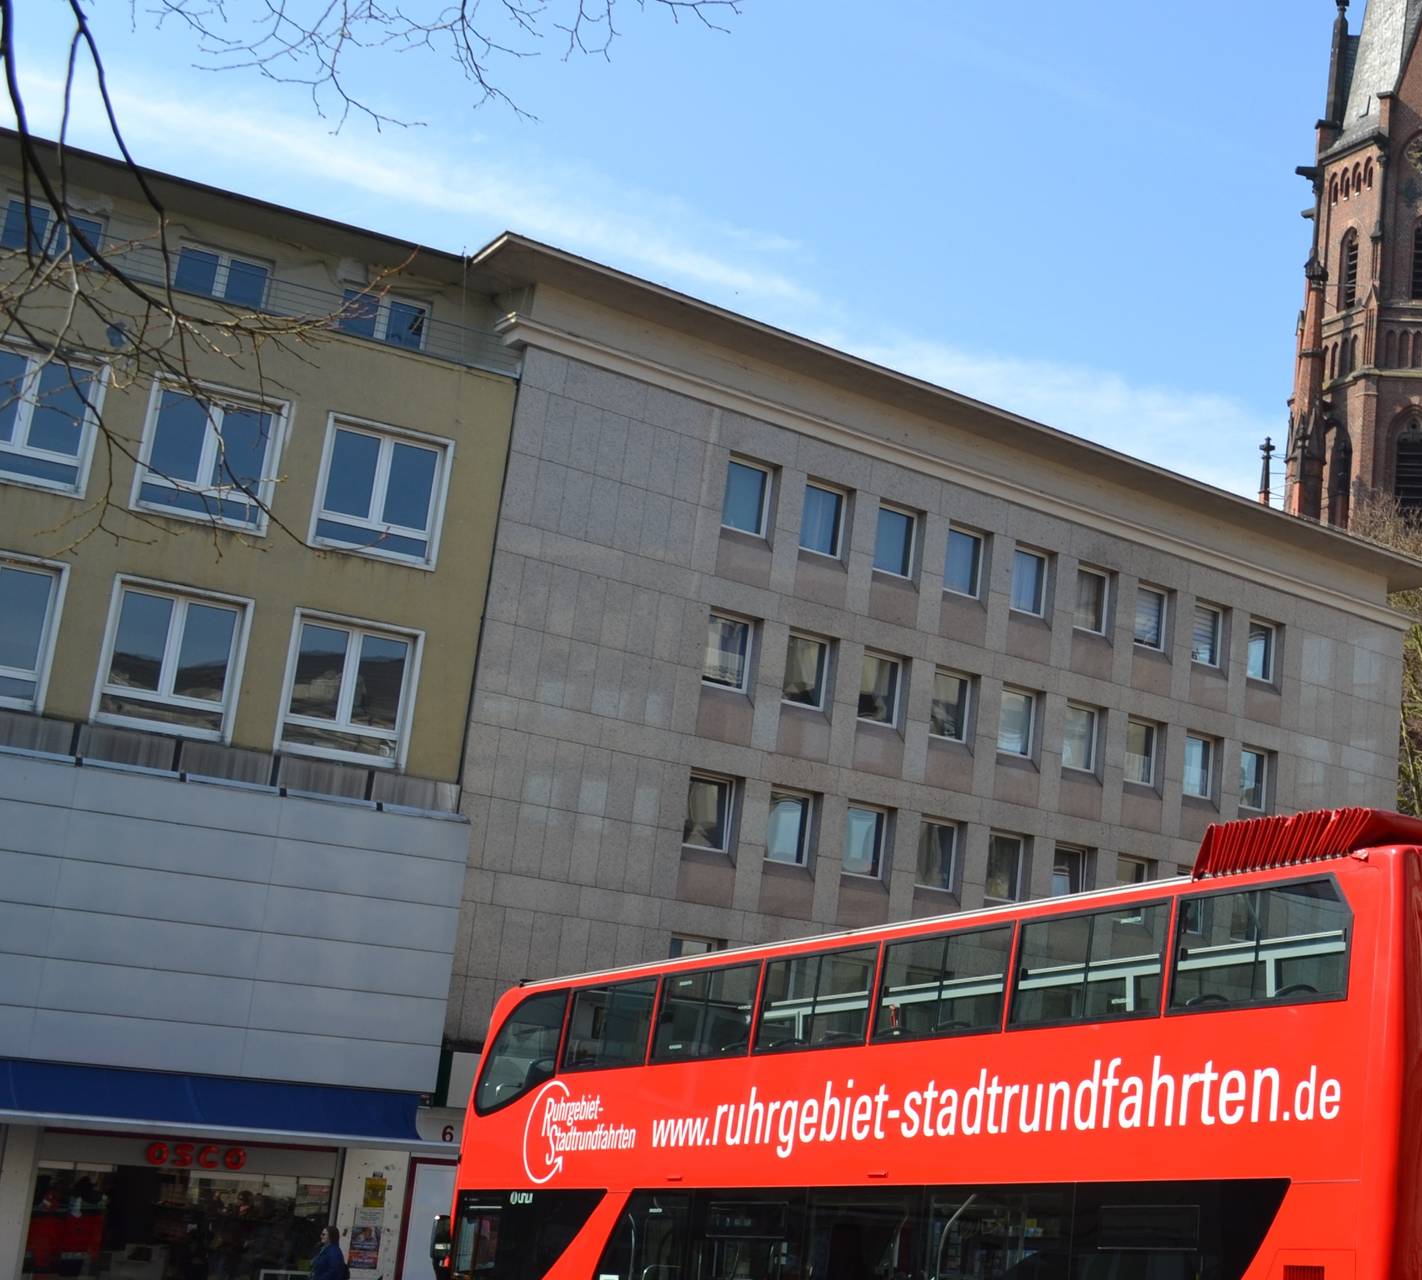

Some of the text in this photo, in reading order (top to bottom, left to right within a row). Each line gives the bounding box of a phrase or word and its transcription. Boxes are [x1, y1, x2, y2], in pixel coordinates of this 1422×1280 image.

[541, 1095, 604, 1136] Ruhrgebiet-
[651, 1056, 1341, 1158] www.ruhrgebiet-stadtrundfahrten.de
[441, 1124, 454, 1143] 6
[545, 1124, 636, 1165] Stadtrundfahrten
[146, 1141, 247, 1170] OSCO
